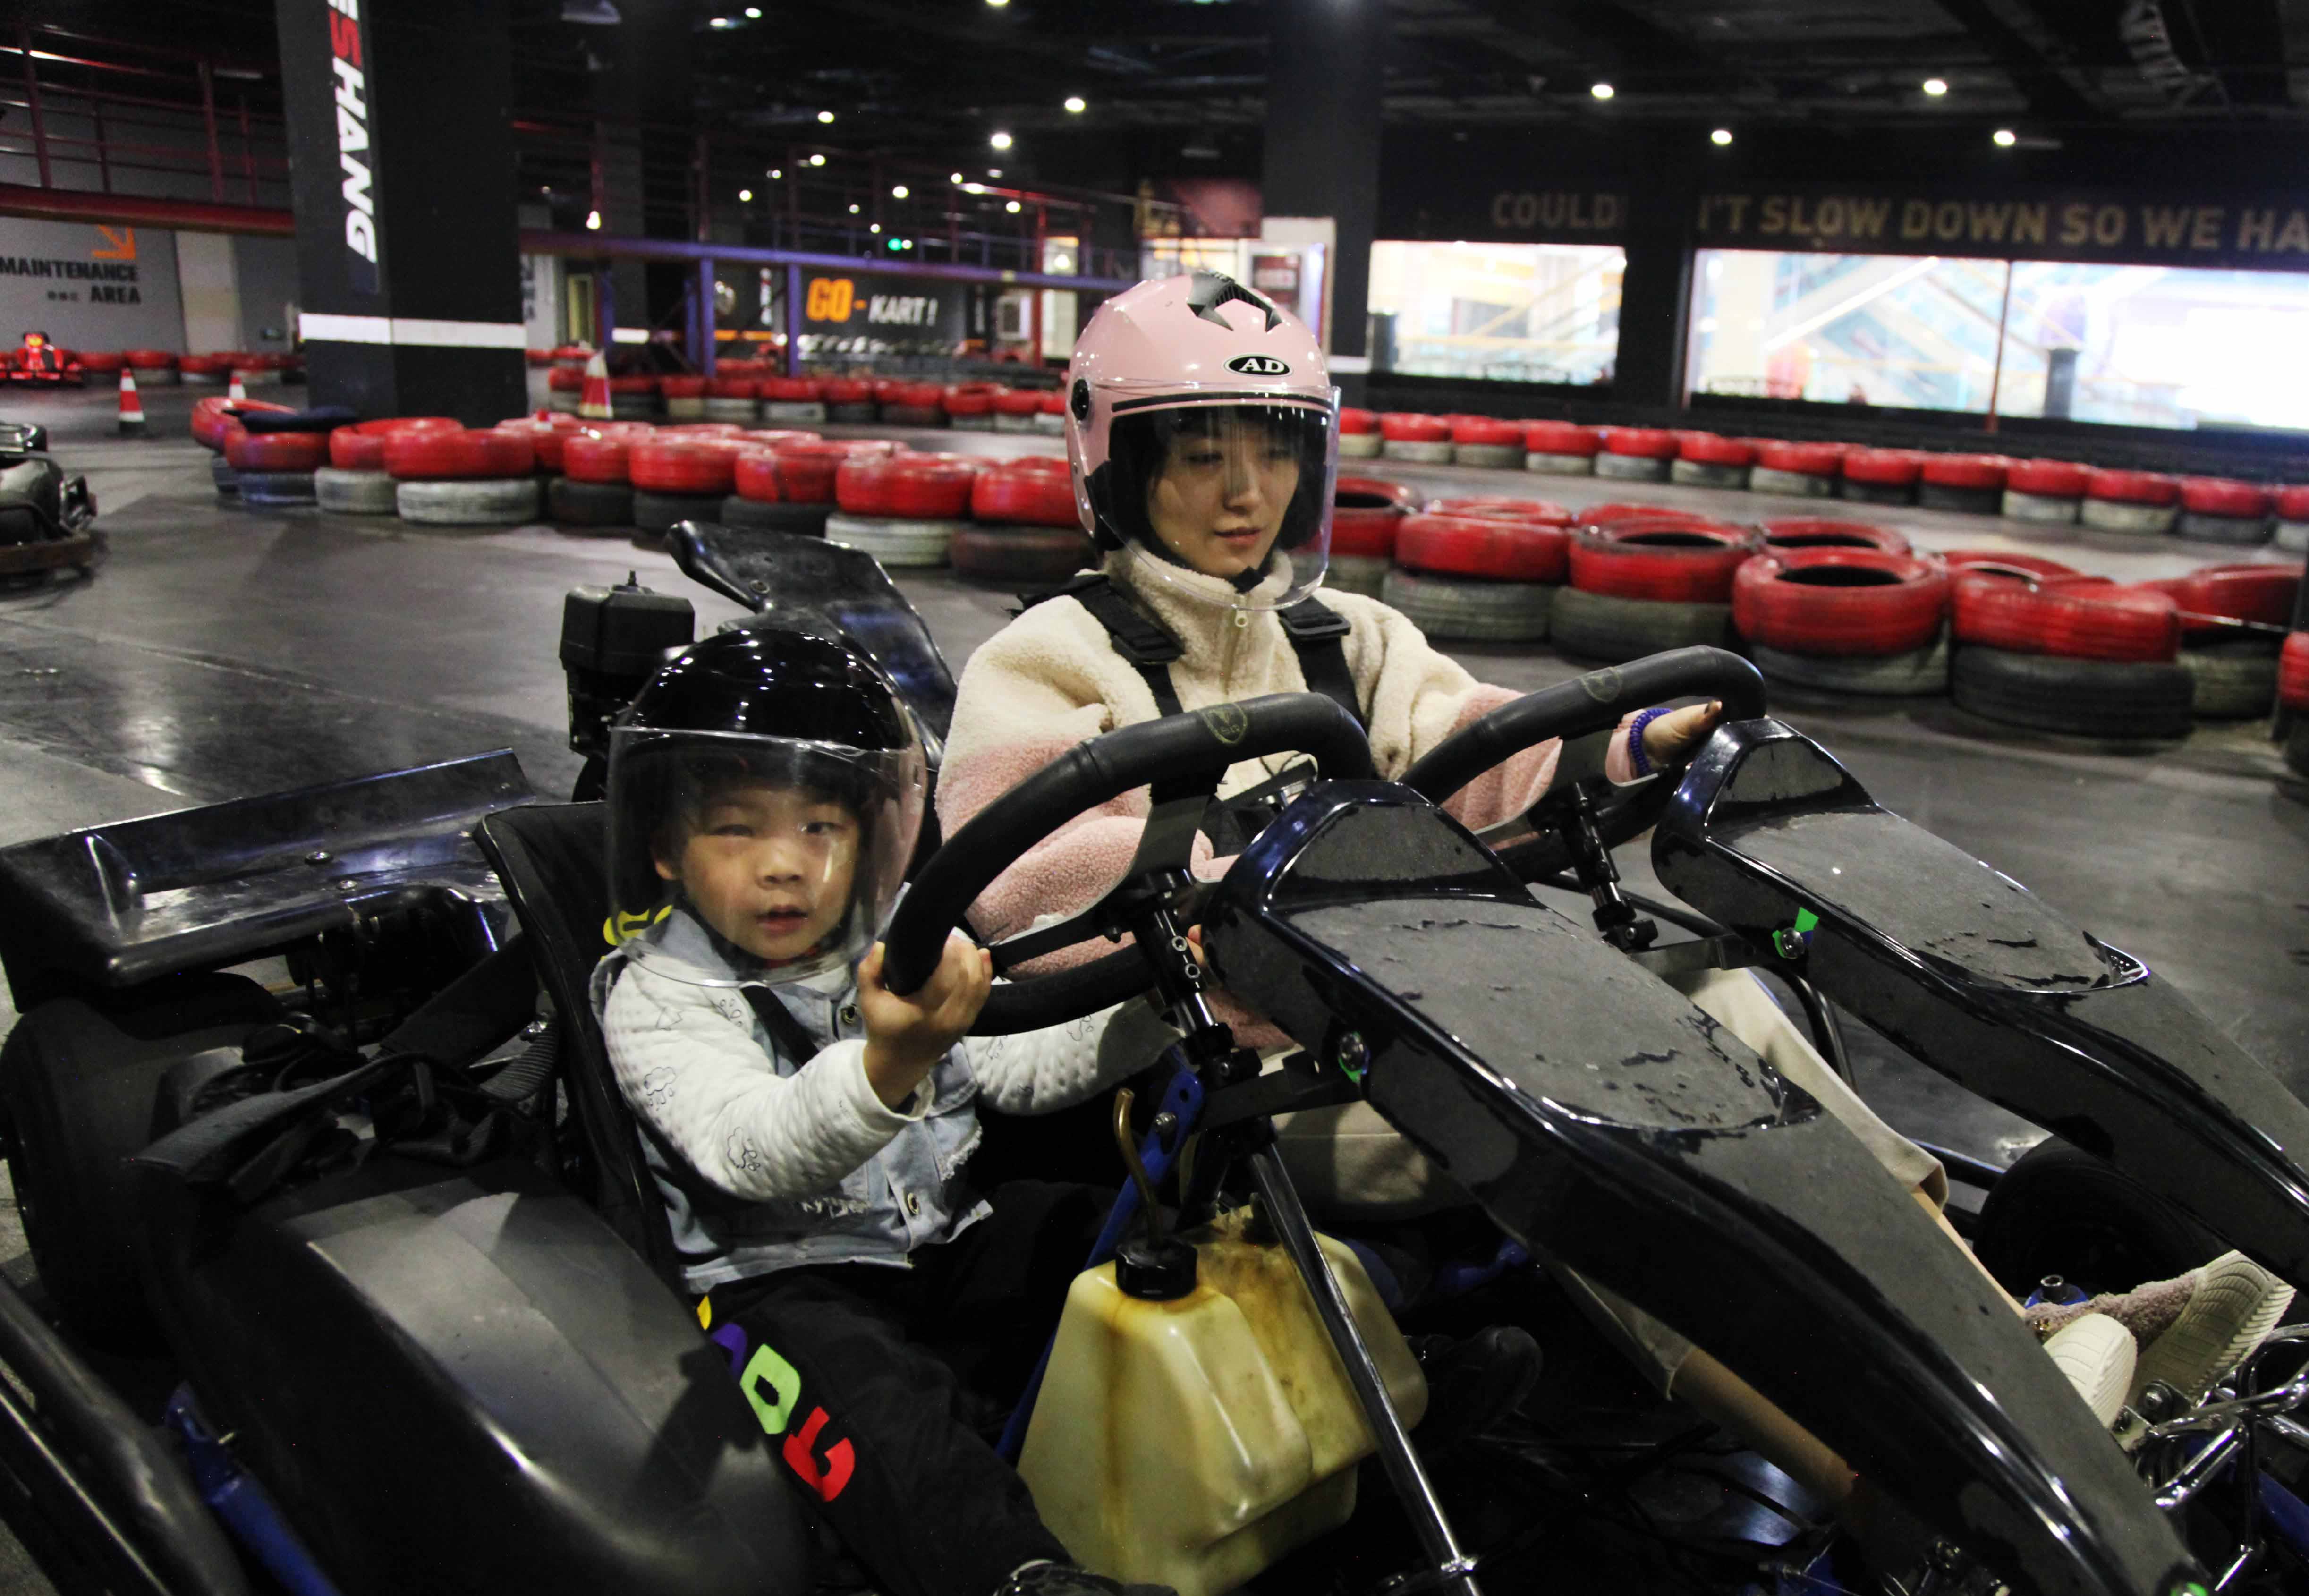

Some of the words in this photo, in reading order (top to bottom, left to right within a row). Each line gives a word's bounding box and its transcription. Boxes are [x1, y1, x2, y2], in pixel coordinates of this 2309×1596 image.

[1758, 195, 1890, 238] SLOW
[1901, 198, 2047, 244] DOWN
[2058, 204, 2128, 246] SO
[2141, 205, 2224, 250] WE
[0, 256, 138, 282] MAINTENANCE
[90, 285, 141, 305] AREA
[1239, 358, 1285, 373] AD
